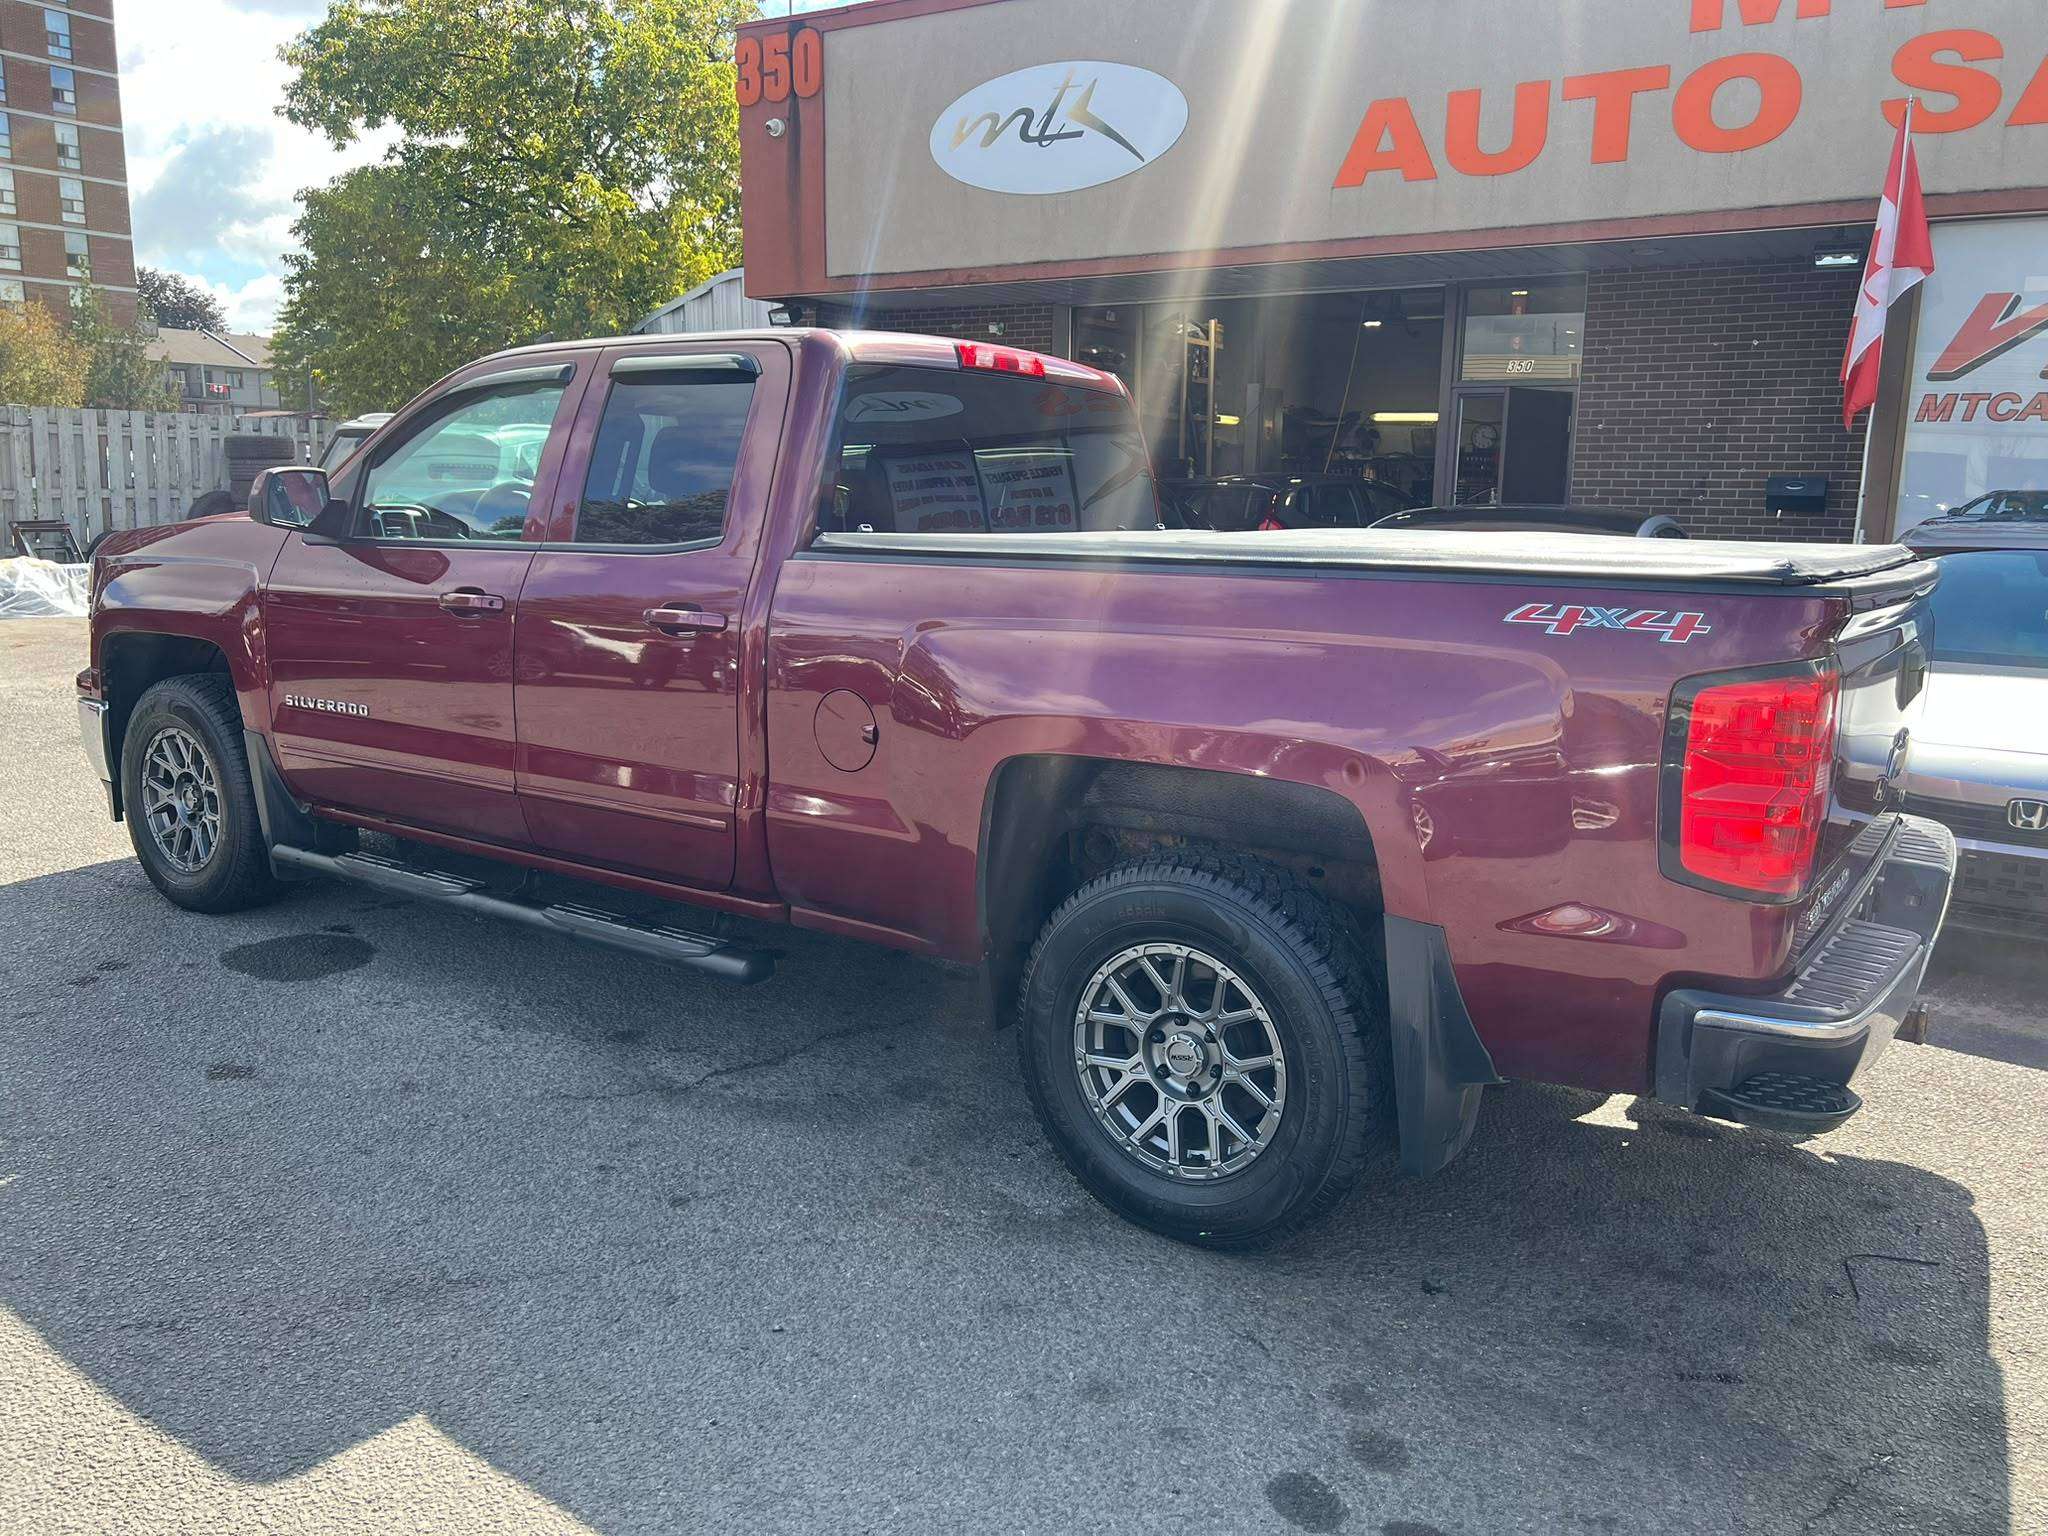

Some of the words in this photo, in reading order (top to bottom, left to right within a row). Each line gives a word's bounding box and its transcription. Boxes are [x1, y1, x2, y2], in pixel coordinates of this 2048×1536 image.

[735, 27, 823, 107] 350
[1332, 51, 1803, 189] AUTO
[1507, 360, 1535, 373] 350
[284, 693, 370, 717] SILVERADO
